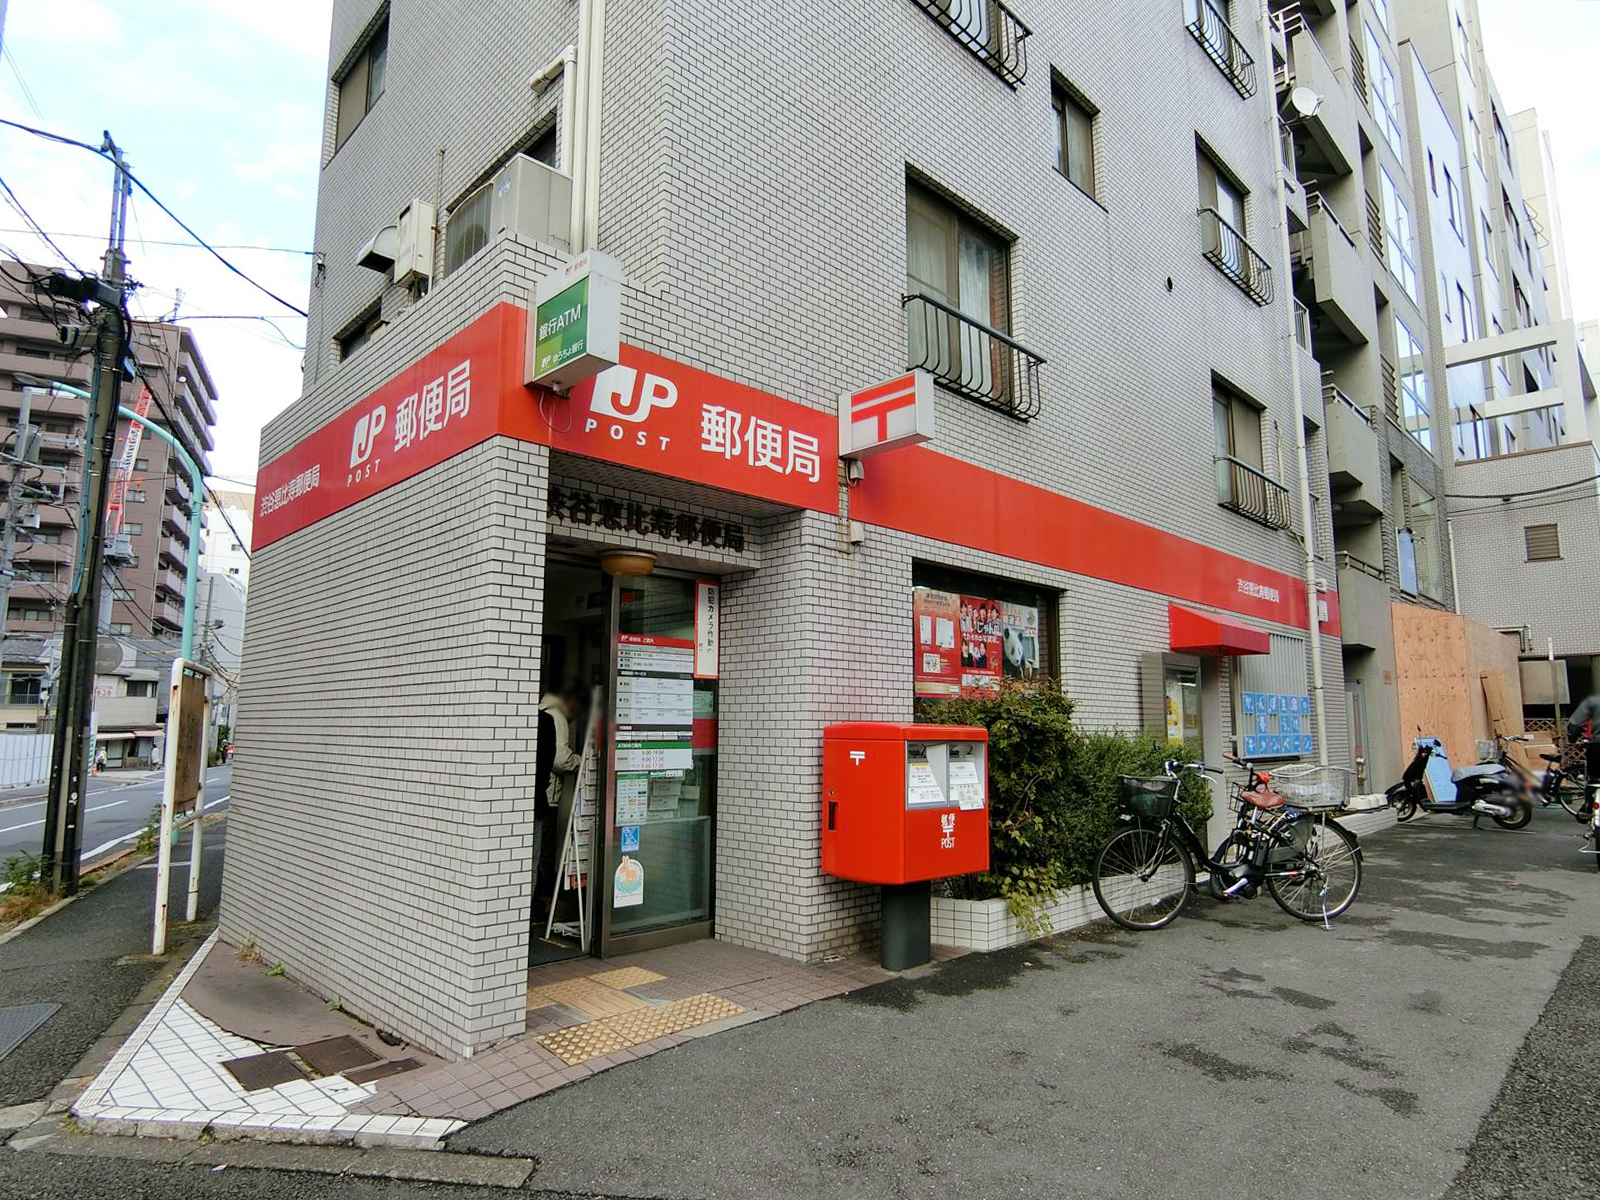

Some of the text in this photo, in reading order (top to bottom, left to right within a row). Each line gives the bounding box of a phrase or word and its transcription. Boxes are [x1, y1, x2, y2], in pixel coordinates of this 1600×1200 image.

[538, 303, 581, 341] 銀行ATM
[552, 339, 584, 363] ゆうちょ銀行
[393, 358, 471, 453] 郵便局
[584, 417, 671, 452] POST
[700, 402, 821, 484] 郵便局
[259, 463, 321, 517] 渋谷恵比寿郵便局
[346, 458, 381, 488] POST
[1246, 736, 1312, 752] キャンペーン
[940, 837, 956, 849] POST
